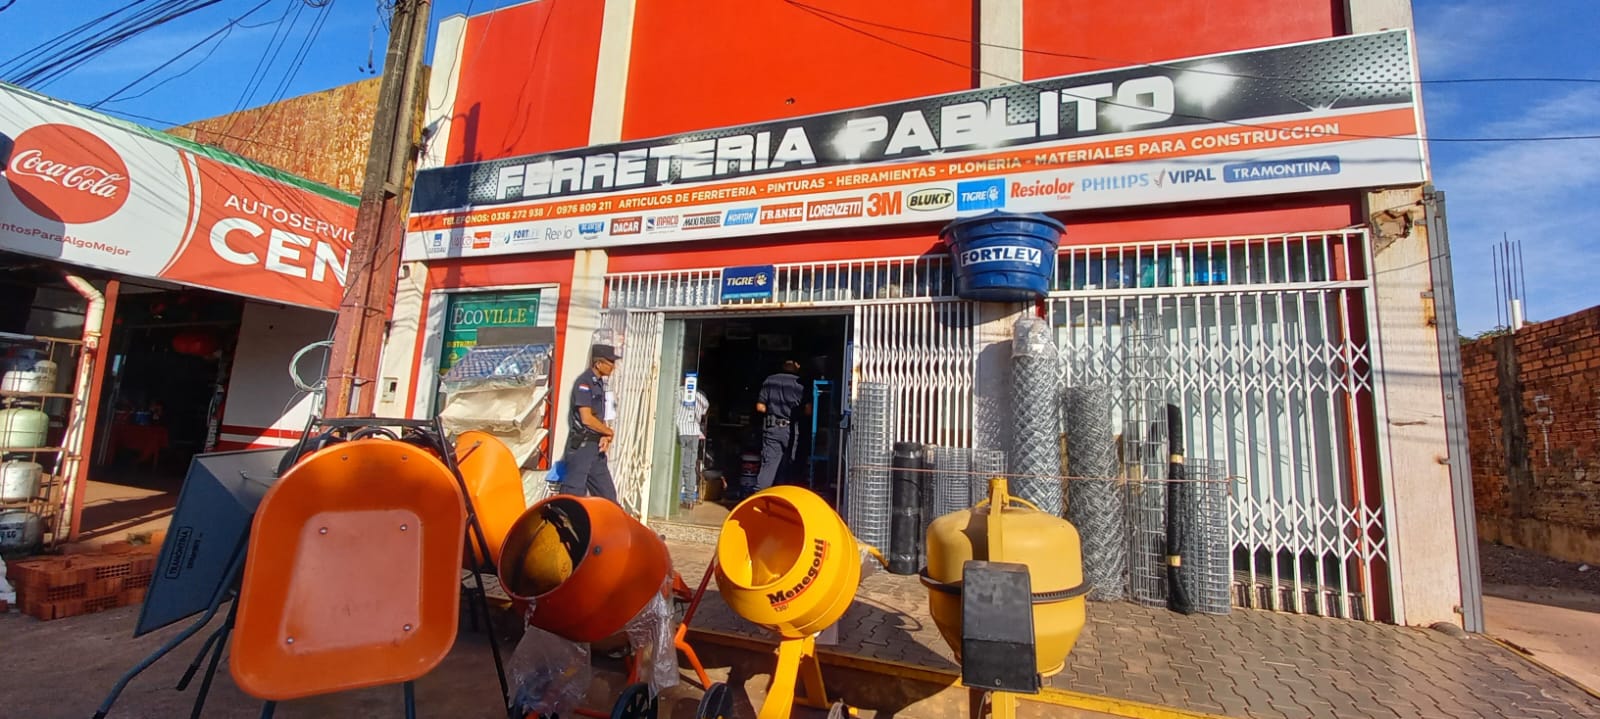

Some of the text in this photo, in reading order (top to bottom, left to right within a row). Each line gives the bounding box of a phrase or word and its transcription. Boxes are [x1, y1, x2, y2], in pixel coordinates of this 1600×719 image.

[495, 75, 1175, 200] FERRETERIA PABLITO
[10, 148, 127, 199] Coca-Cola
[513, 210, 526, 219] 272
[528, 208, 544, 218] 938
[580, 203, 597, 213] 809
[598, 201, 612, 211] 211
[618, 194, 673, 209] ARTICULOS
[675, 193, 690, 203] DE
[691, 186, 757, 202] FERRETERIA
[767, 178, 825, 194] PINTURAS
[836, 165, 936, 187] HERRAMIENTAS
[949, 156, 1022, 175] PLOMERIA
[1035, 144, 1134, 166] MATERIALES
[1139, 138, 1186, 156] PARA
[1190, 122, 1340, 150] CONSTRUCCION
[1168, 166, 1217, 185] VIPAL
[1232, 160, 1332, 179] TRAMONTINA
[1010, 177, 1075, 199] Resicolor
[1081, 172, 1149, 192] PHILIPS
[866, 190, 903, 218] 3M
[961, 191, 988, 203] TIGRE
[761, 207, 803, 221] FRANKE
[809, 201, 861, 218] LORENZETTI
[612, 221, 640, 233] DACAR
[0, 221, 132, 257] ntosParaAlgoMejor
[961, 247, 1039, 265] FORTLEV
[726, 275, 754, 287] TIGRE
[766, 537, 825, 605] Menegotti
